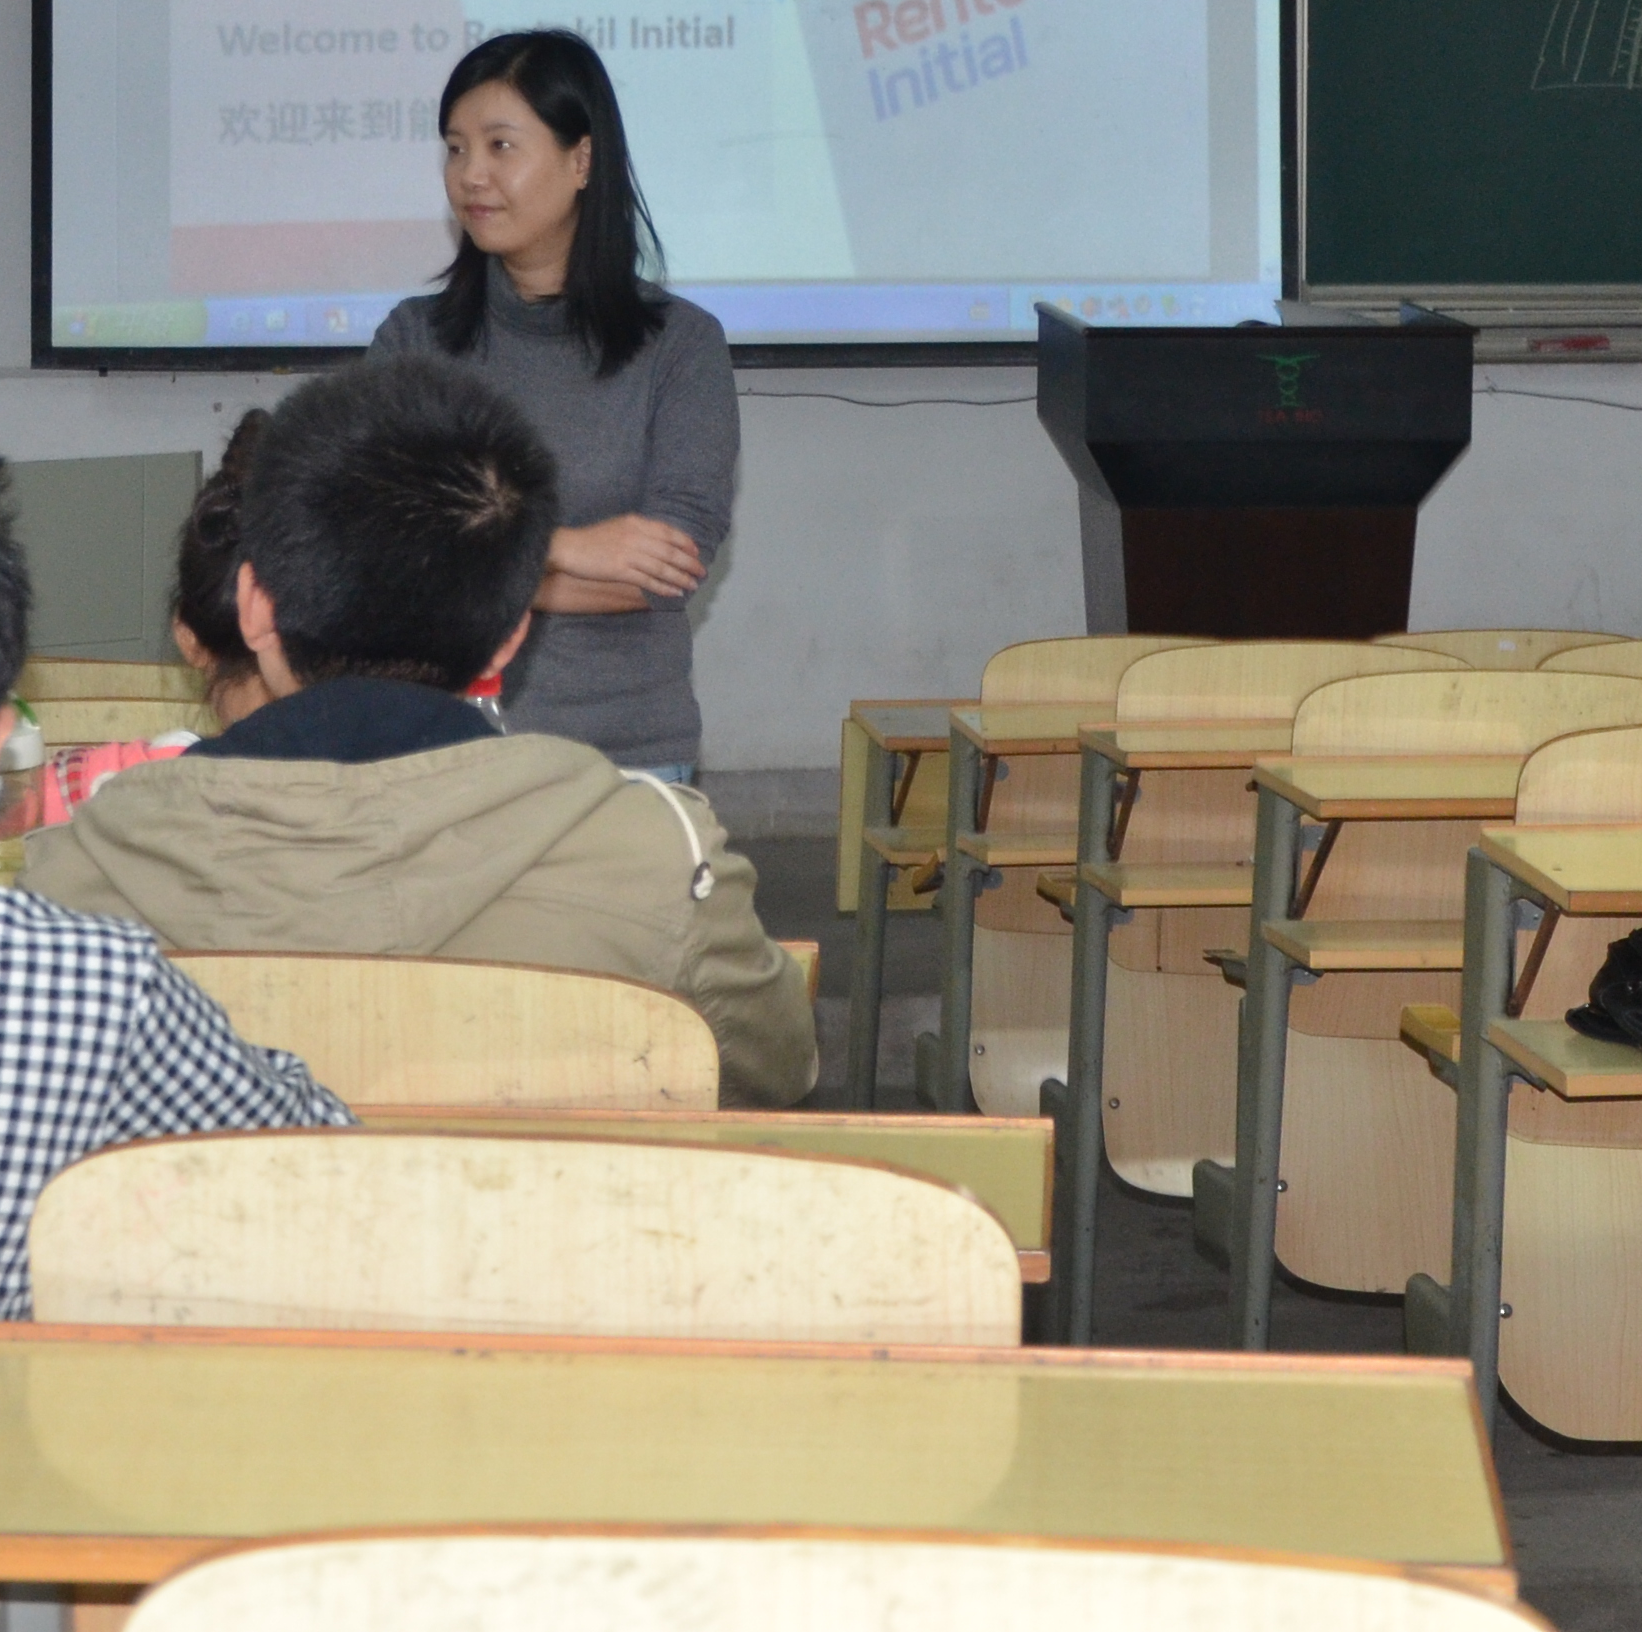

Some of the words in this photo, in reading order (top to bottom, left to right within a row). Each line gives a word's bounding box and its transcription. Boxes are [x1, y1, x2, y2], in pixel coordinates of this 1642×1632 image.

[217, 21, 399, 56] Welcome
[410, 23, 450, 52] to
[630, 16, 735, 49] Initial
[867, 16, 1029, 122] Initial
